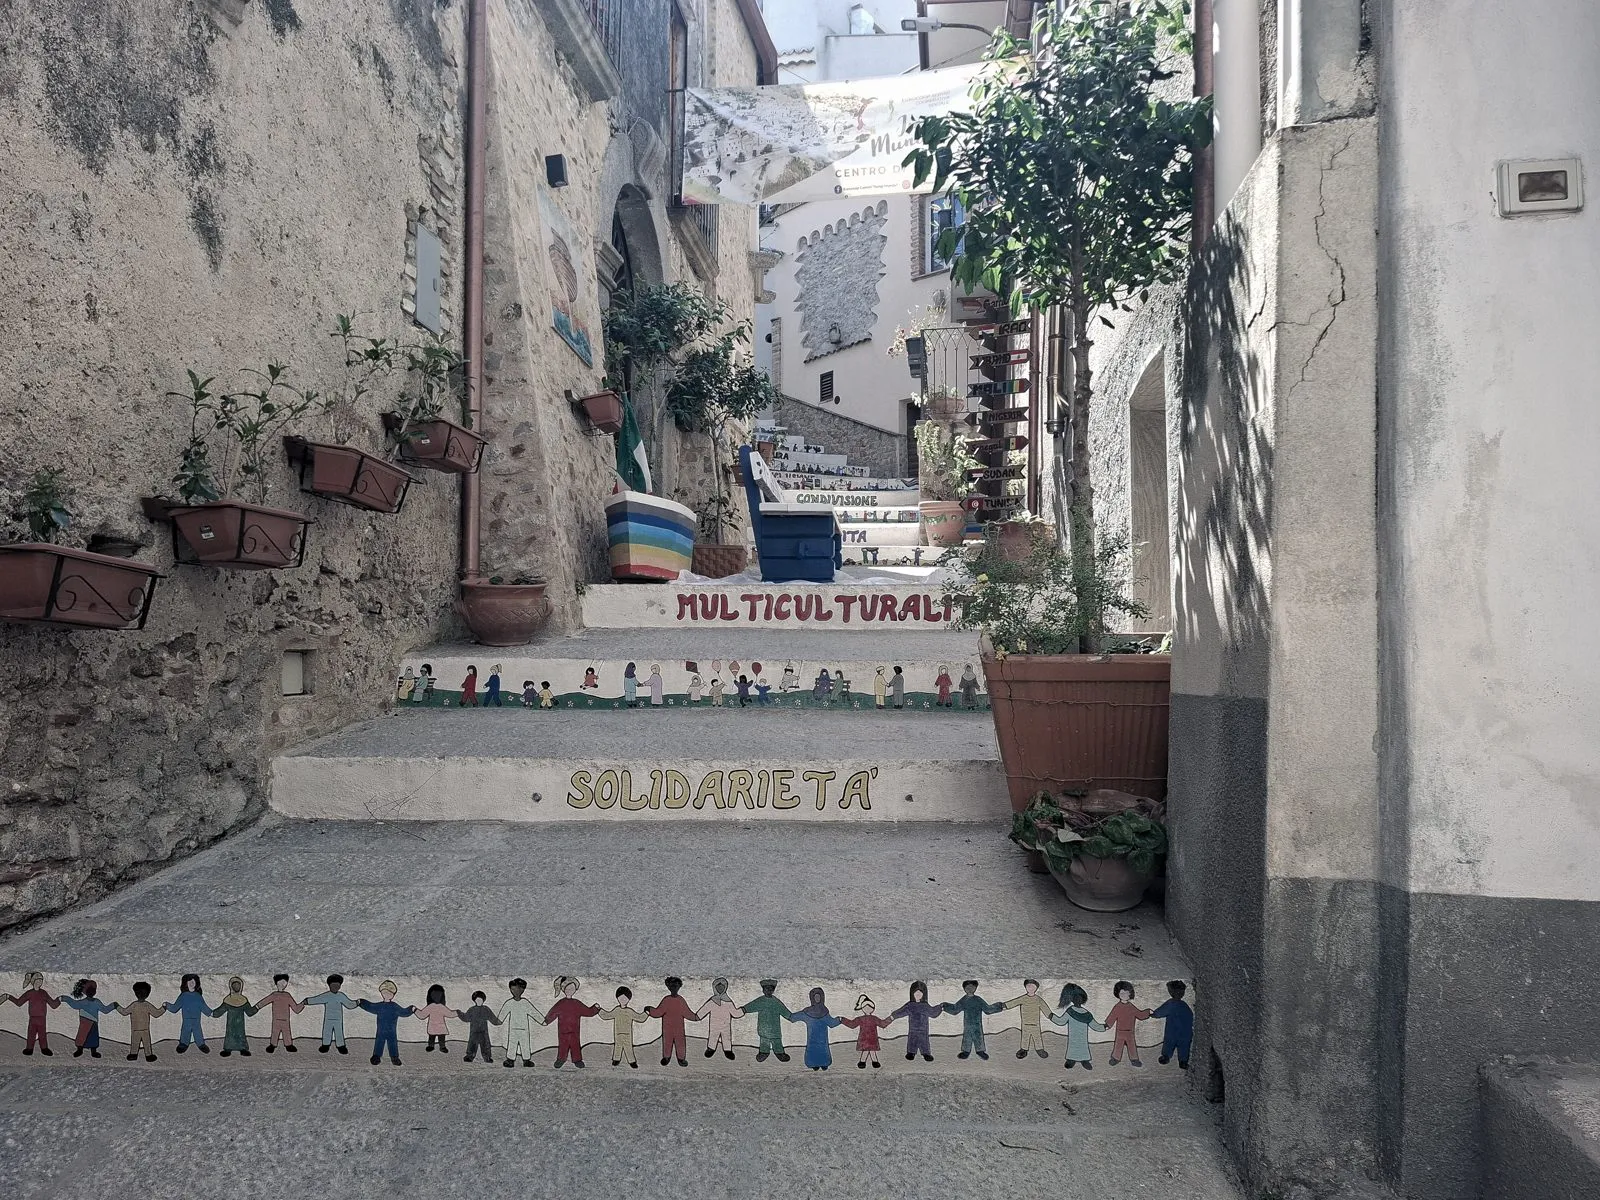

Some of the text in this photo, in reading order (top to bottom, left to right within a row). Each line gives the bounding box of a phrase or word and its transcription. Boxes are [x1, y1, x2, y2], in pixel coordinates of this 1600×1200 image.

[835, 166, 886, 178] CENTRO
[999, 320, 1027, 335] IRAQ
[972, 382, 1007, 396] MALI
[988, 409, 1022, 422] NIGERIA
[983, 468, 1015, 480] SUDAN
[796, 492, 879, 507] CONDIVISIONE
[984, 497, 1020, 508] TUNISIA
